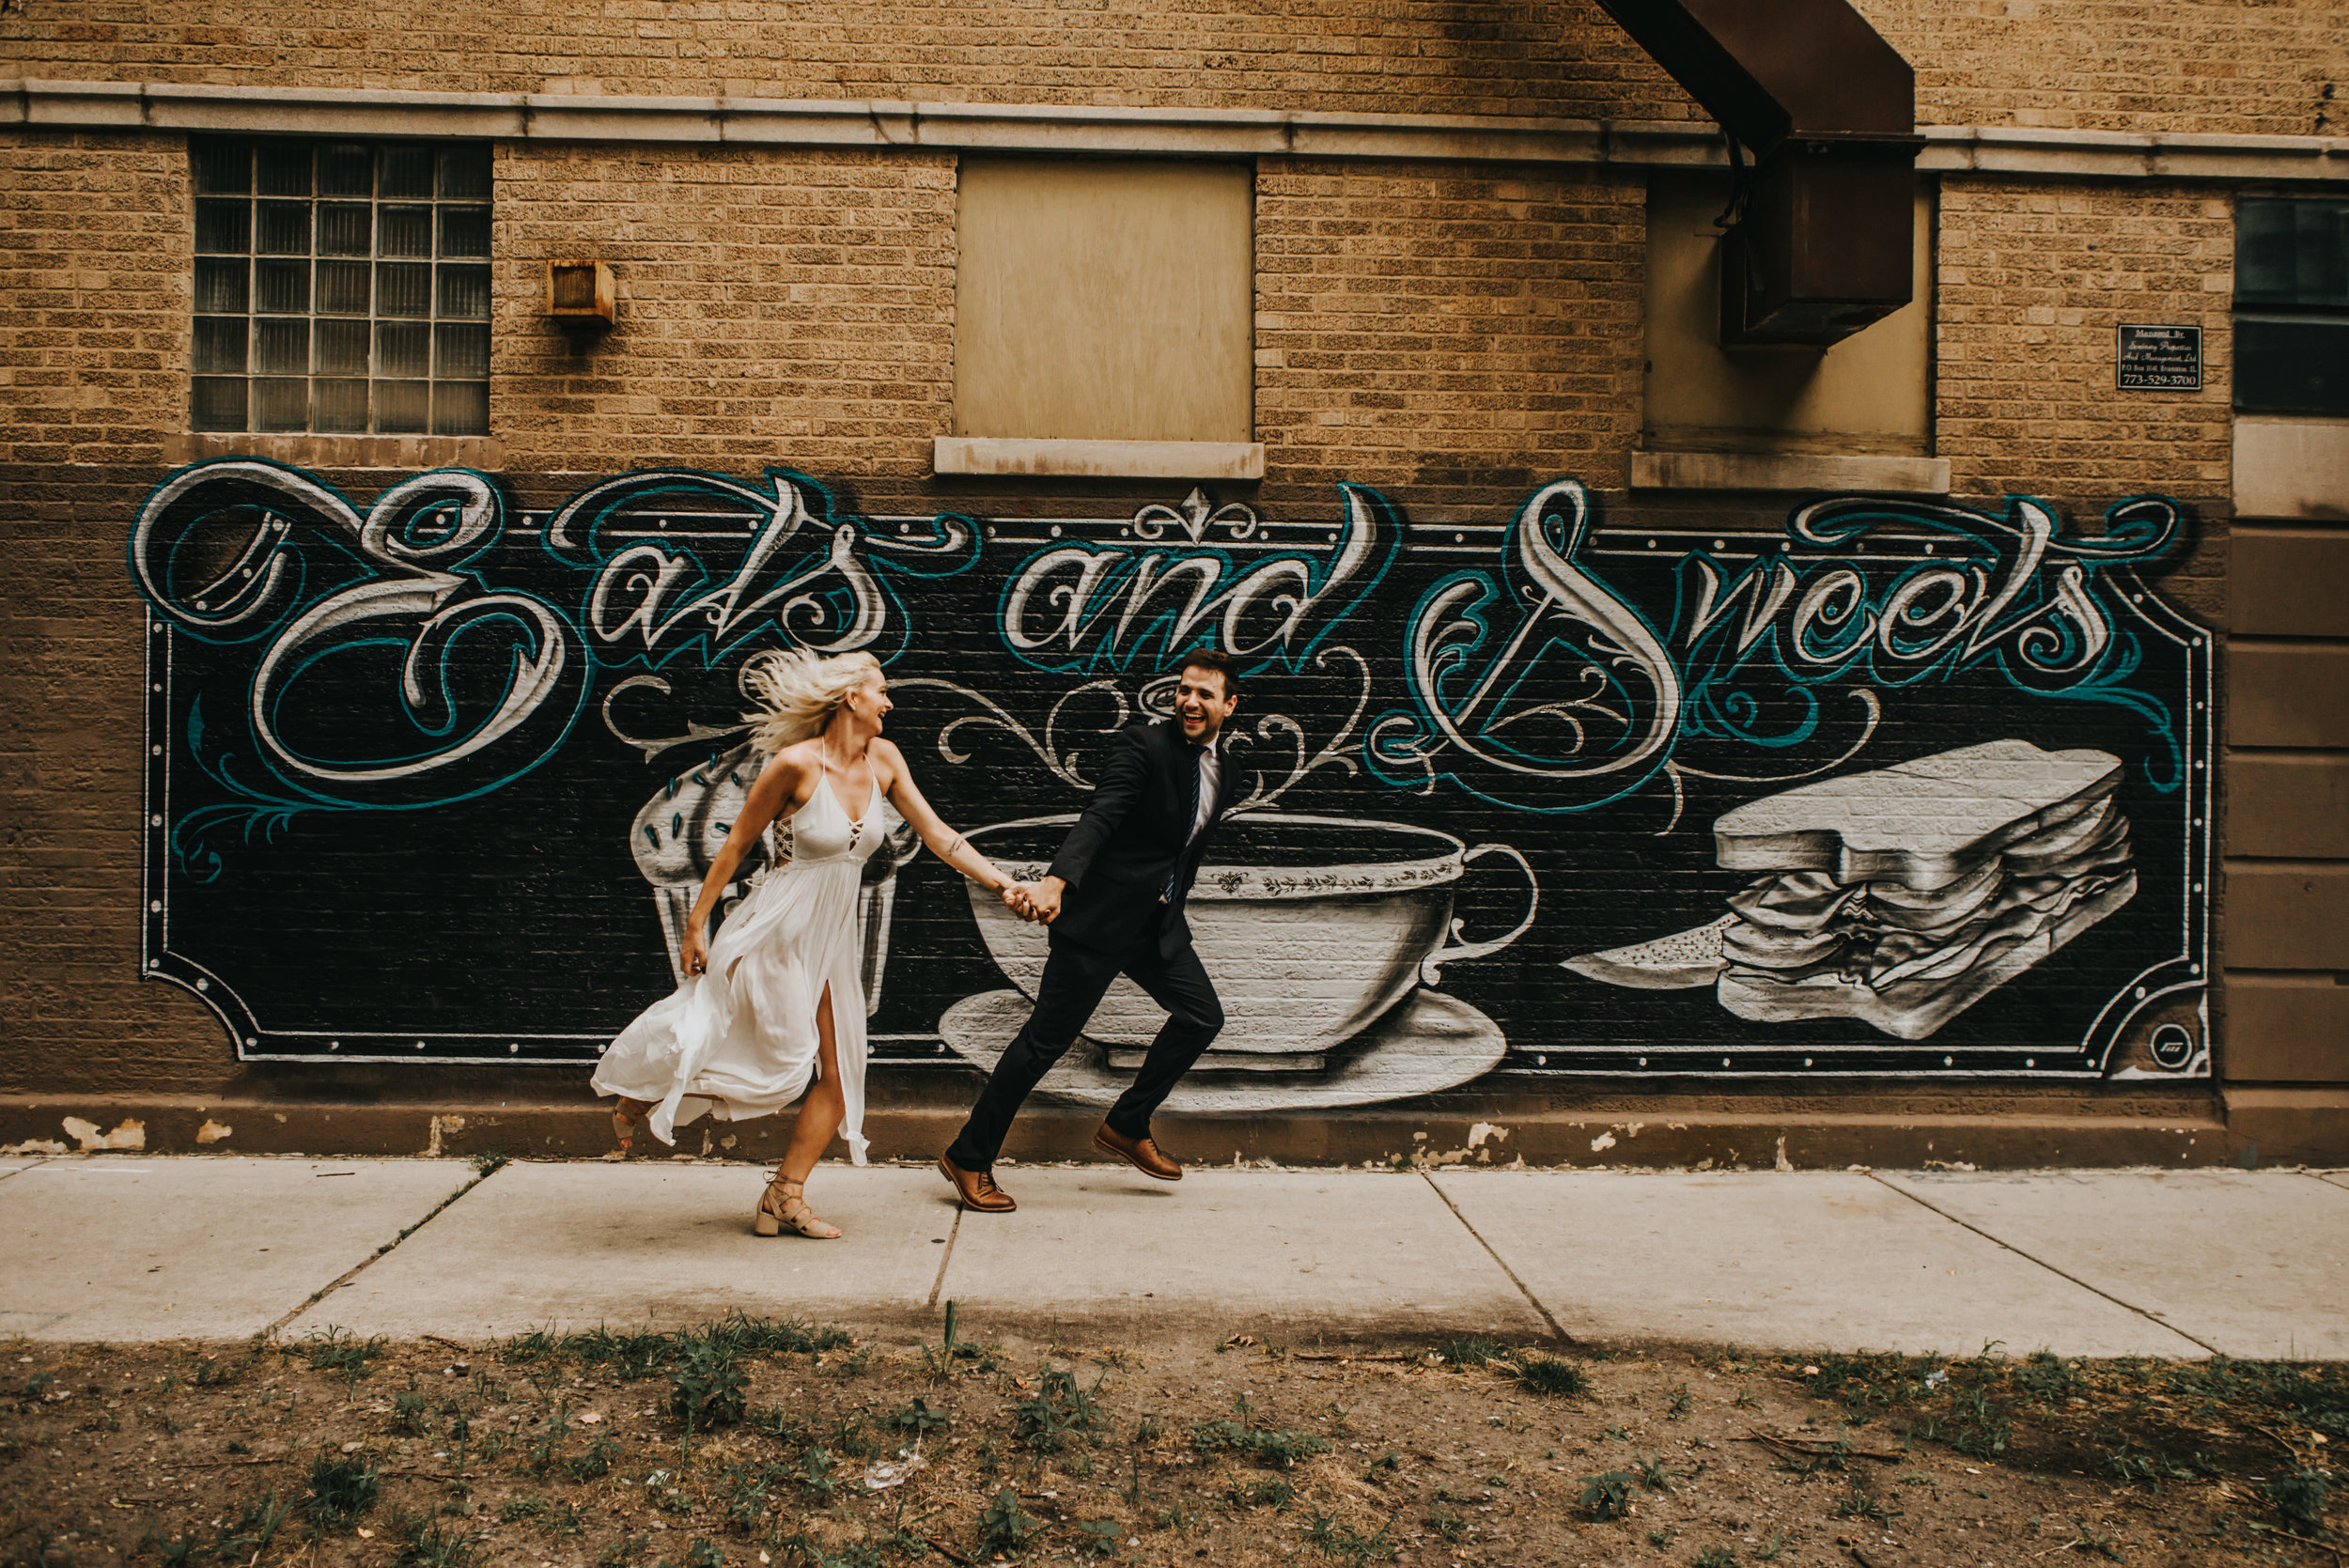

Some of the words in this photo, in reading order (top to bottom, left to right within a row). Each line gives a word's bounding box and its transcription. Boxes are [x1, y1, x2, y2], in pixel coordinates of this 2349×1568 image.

[2123, 374, 2196, 385] 773-529-3700
[130, 458, 972, 784] Eats
[1002, 483, 1383, 660] and
[1400, 477, 2178, 780] Sweets
